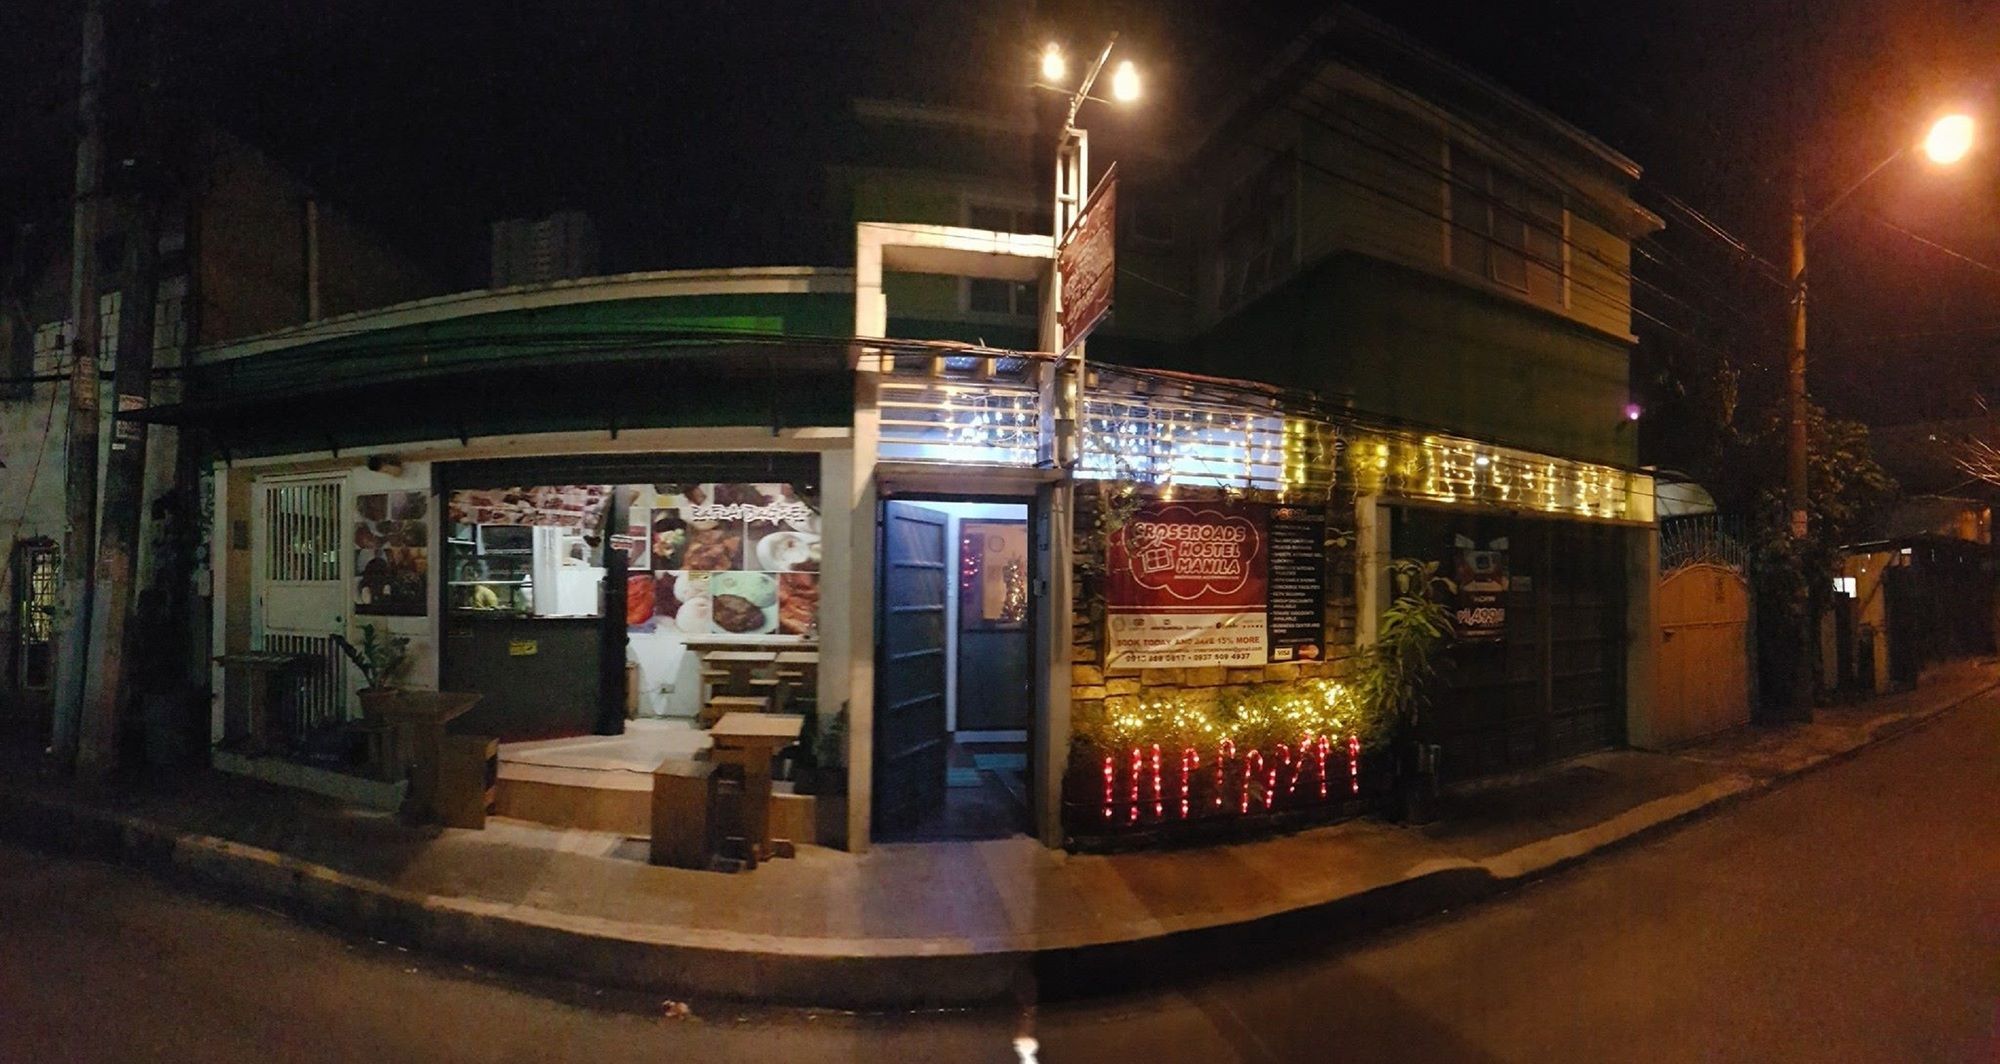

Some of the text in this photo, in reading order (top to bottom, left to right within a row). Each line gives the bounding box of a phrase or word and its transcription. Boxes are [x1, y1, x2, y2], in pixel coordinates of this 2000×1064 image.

[1135, 522, 1246, 542] CROSSROADS
[1179, 541, 1241, 558] HOSTEL
[1176, 557, 1241, 575] MANILA
